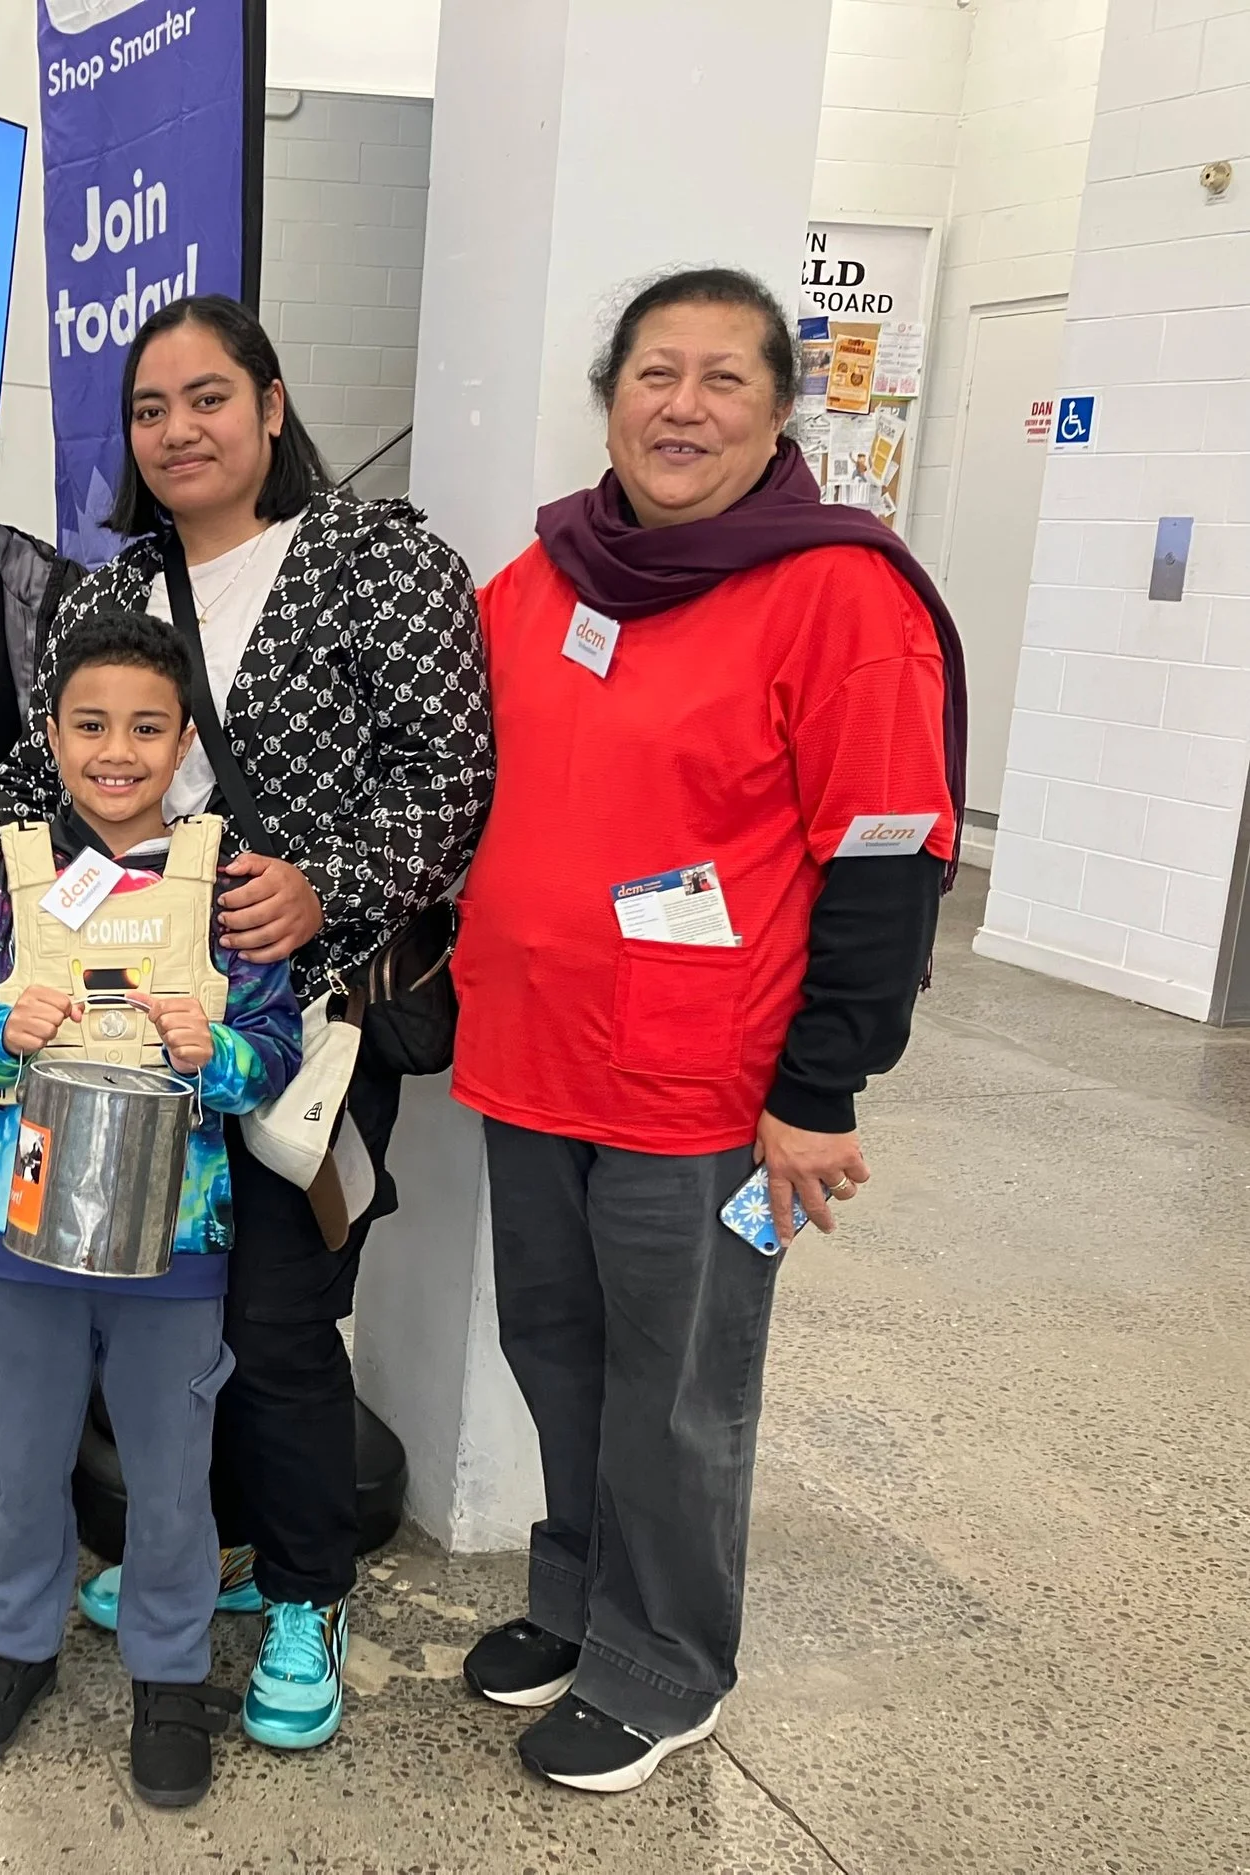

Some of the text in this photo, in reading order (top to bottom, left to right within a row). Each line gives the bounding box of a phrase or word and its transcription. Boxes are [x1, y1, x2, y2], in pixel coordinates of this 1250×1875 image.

[48, 6, 196, 97] Shop Smarter
[71, 168, 166, 263] Join
[805, 232, 827, 253] N
[801, 259, 866, 287] LD
[805, 291, 894, 314] BOARD
[575, 616, 607, 652] dcm
[861, 822, 917, 841] dcm
[60, 867, 101, 909] dcm
[618, 884, 645, 898] dcm
[86, 918, 164, 945] COMBAT
